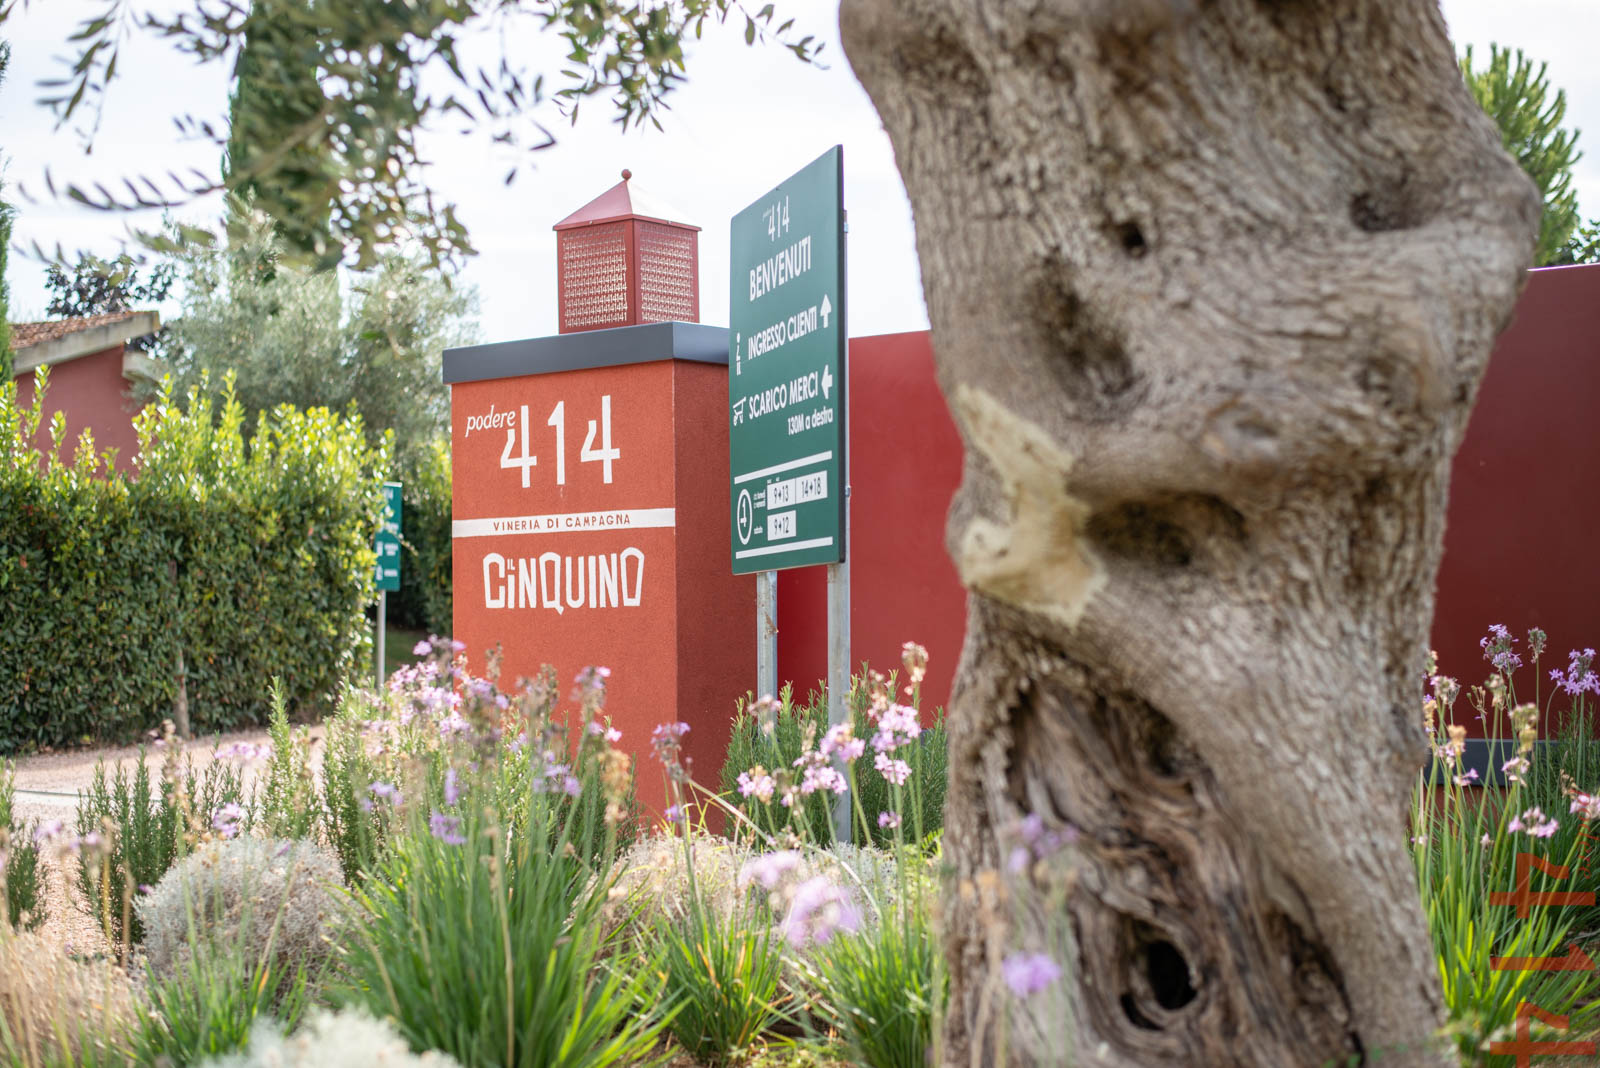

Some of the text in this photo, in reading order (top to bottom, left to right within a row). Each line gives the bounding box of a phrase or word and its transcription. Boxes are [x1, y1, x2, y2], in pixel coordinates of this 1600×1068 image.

[768, 195, 790, 242] 414
[749, 235, 811, 302] BENVENUTI
[748, 305, 817, 360] INGRESSO CLIENTI
[748, 371, 818, 420] SCARICO MERCI
[805, 415, 811, 430] a
[811, 406, 833, 428] destra
[465, 404, 516, 438] podere
[500, 395, 620, 488] 414
[493, 514, 631, 532] VINERIA DI CAMPAGNA
